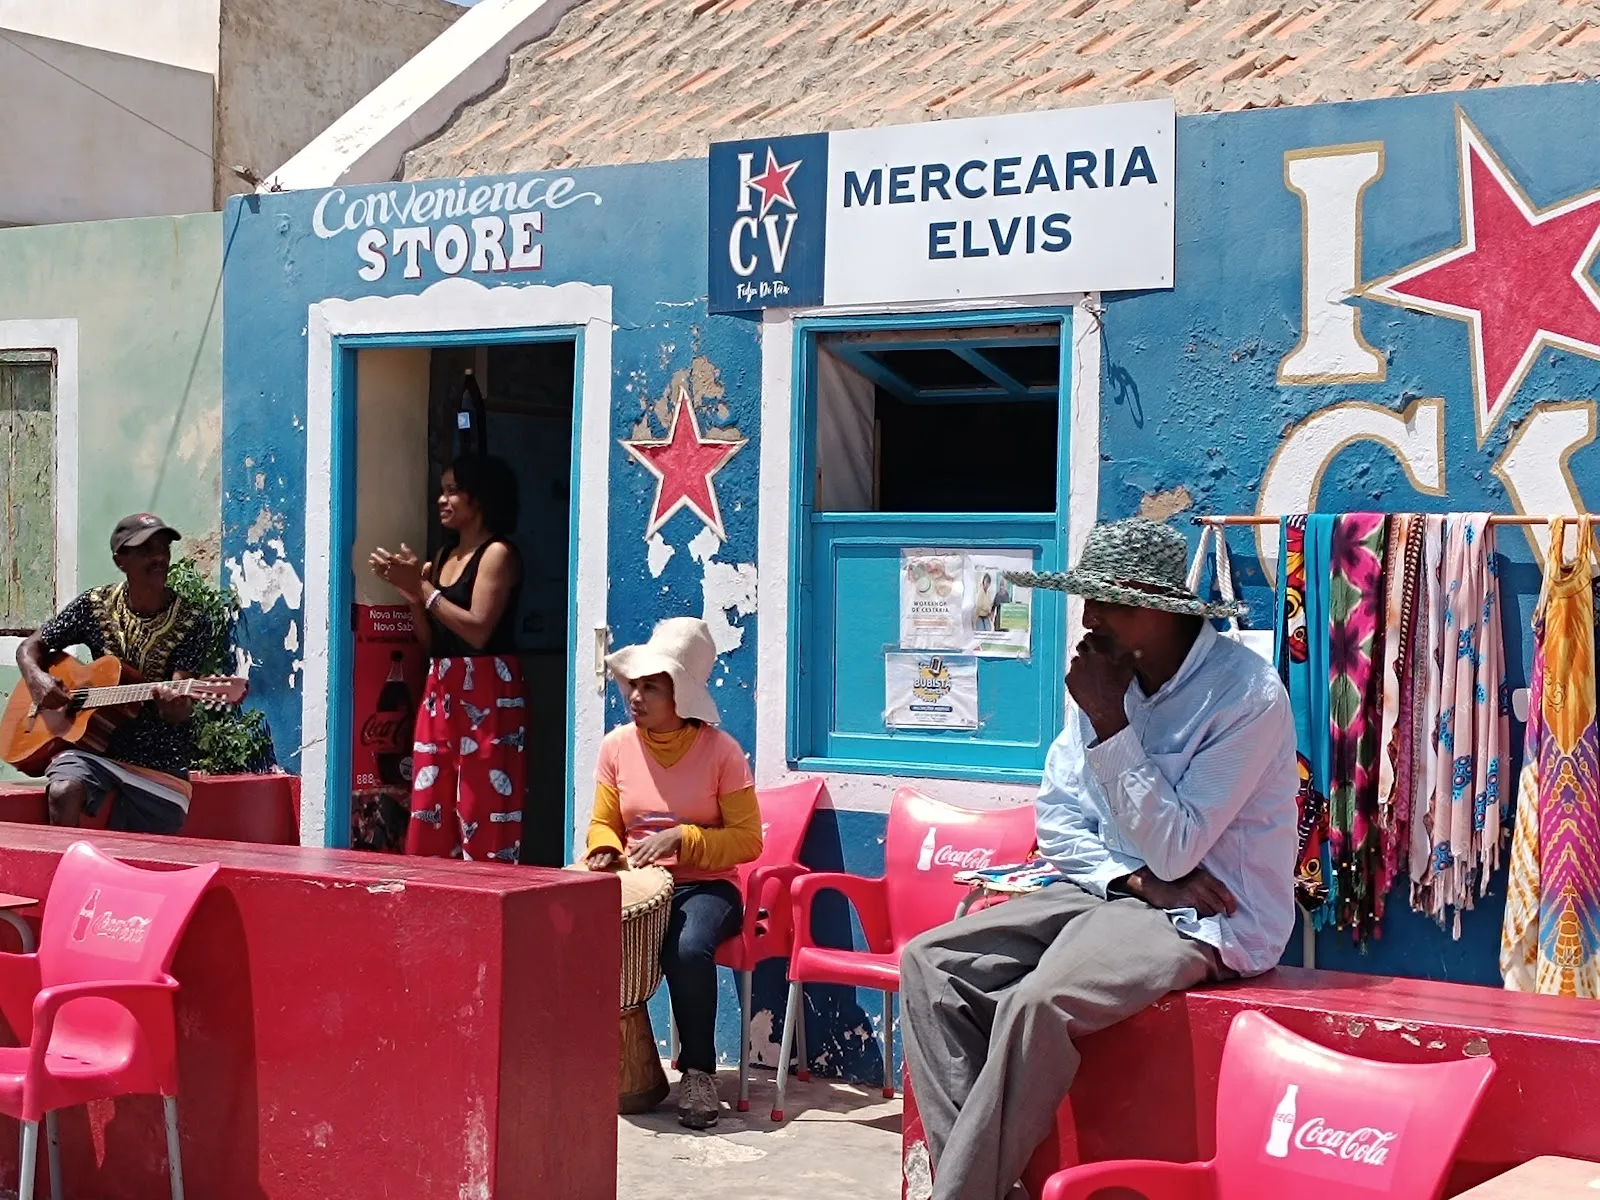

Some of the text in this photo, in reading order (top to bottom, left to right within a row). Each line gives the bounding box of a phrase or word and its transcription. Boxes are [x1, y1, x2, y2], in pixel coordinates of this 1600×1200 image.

[312, 176, 602, 239] Convenience
[736, 152, 754, 213] I
[843, 146, 1159, 208] MERCEARIA
[357, 211, 544, 282] STORE
[729, 213, 799, 277] CV
[928, 213, 1072, 260] ELVIS
[1277, 141, 1386, 385] I
[369, 610, 413, 621] Nova Imag
[374, 622, 415, 631] Novo Sab
[914, 679, 951, 690] BUBISTA
